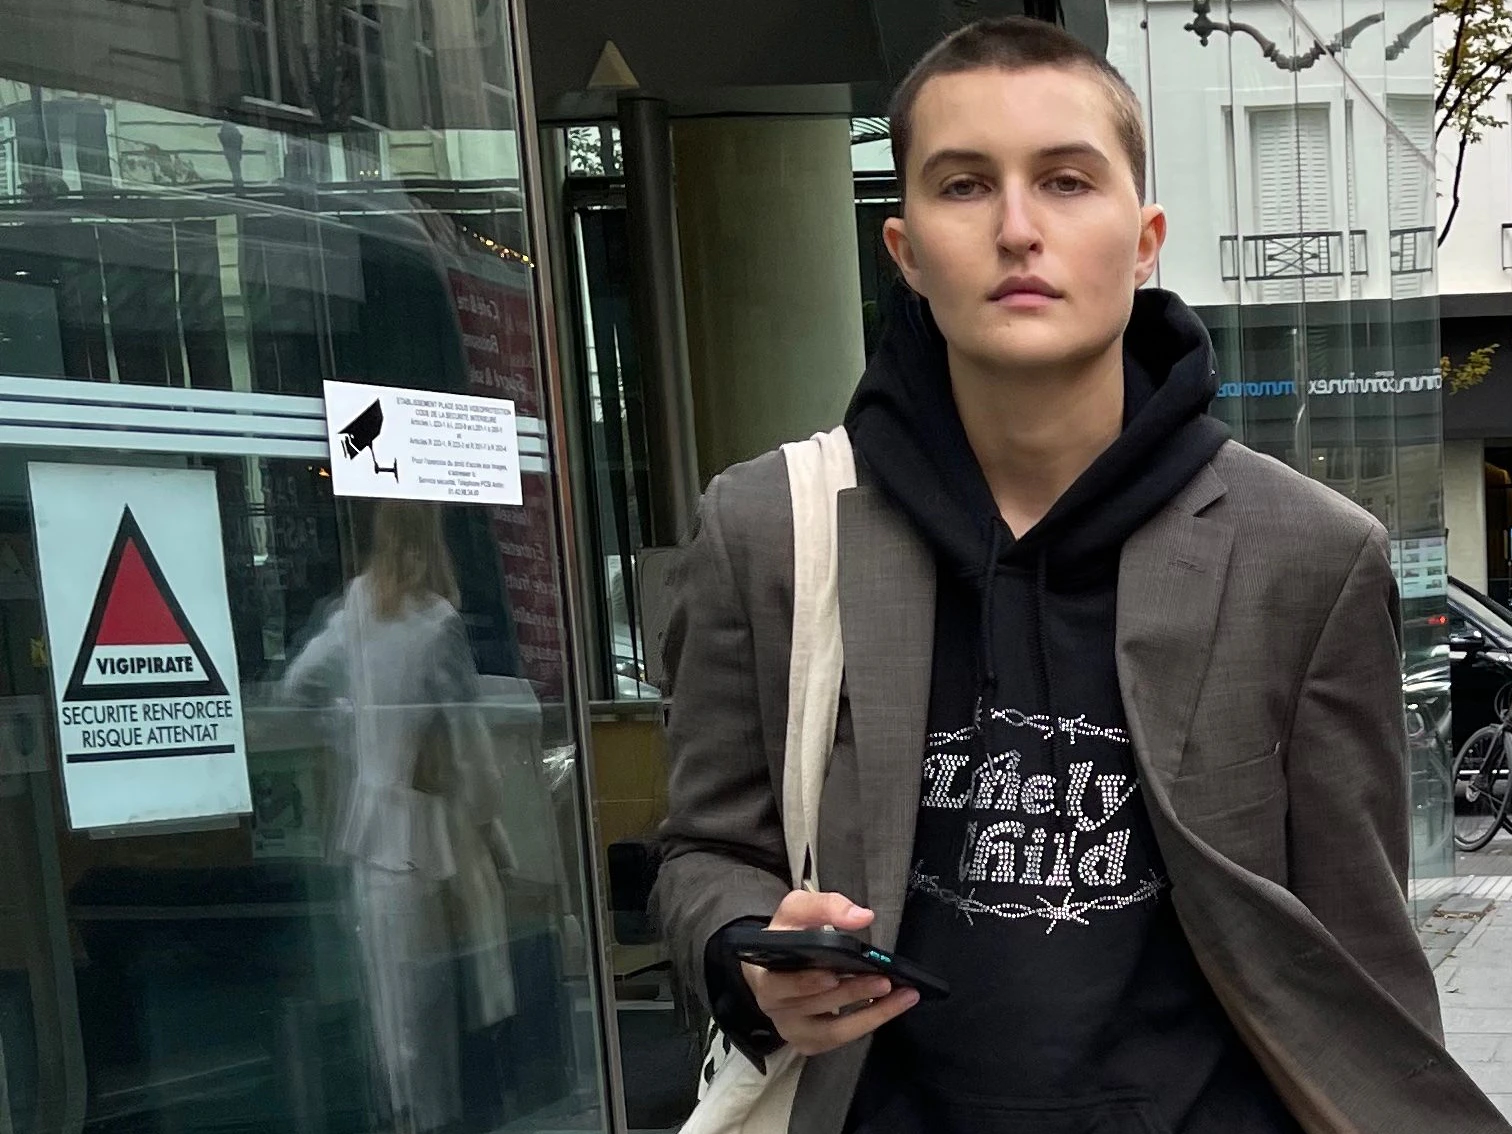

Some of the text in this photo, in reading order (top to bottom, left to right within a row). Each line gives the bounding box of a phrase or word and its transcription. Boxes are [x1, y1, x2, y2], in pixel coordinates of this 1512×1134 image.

[96, 655, 194, 676] VIGIPIRATE
[62, 699, 233, 726] SECURITE RENFORCEE
[81, 723, 219, 749] RISQUE ATTENTAT
